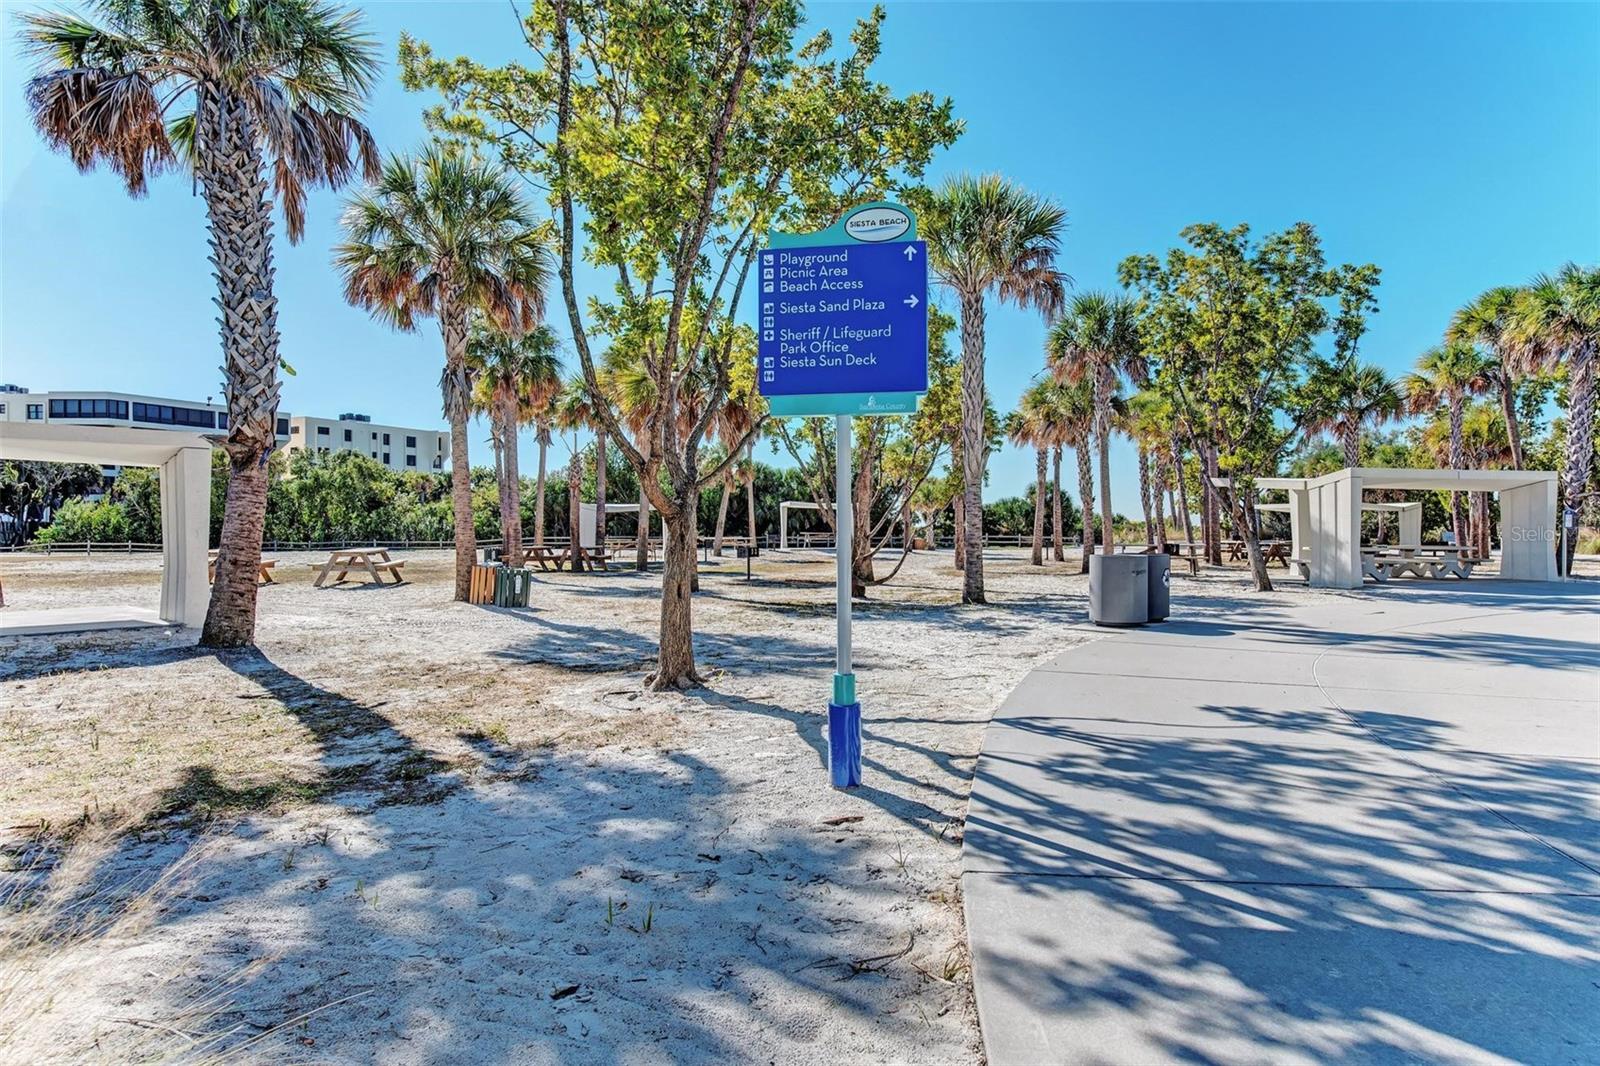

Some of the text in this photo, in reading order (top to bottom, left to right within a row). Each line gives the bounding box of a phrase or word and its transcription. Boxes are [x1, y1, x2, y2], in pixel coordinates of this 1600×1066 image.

[849, 218, 907, 228] SIESTA BEACH
[780, 250, 848, 267] Playground
[780, 267, 848, 279] Picnic Area
[780, 279, 863, 292] Beach Access
[780, 299, 885, 314] Siesta Sand Plaza
[780, 328, 821, 341] Sheriff
[833, 325, 891, 341] Lifeguard
[780, 341, 849, 354] Park Office
[780, 354, 877, 367] Siesta Sun Deck
